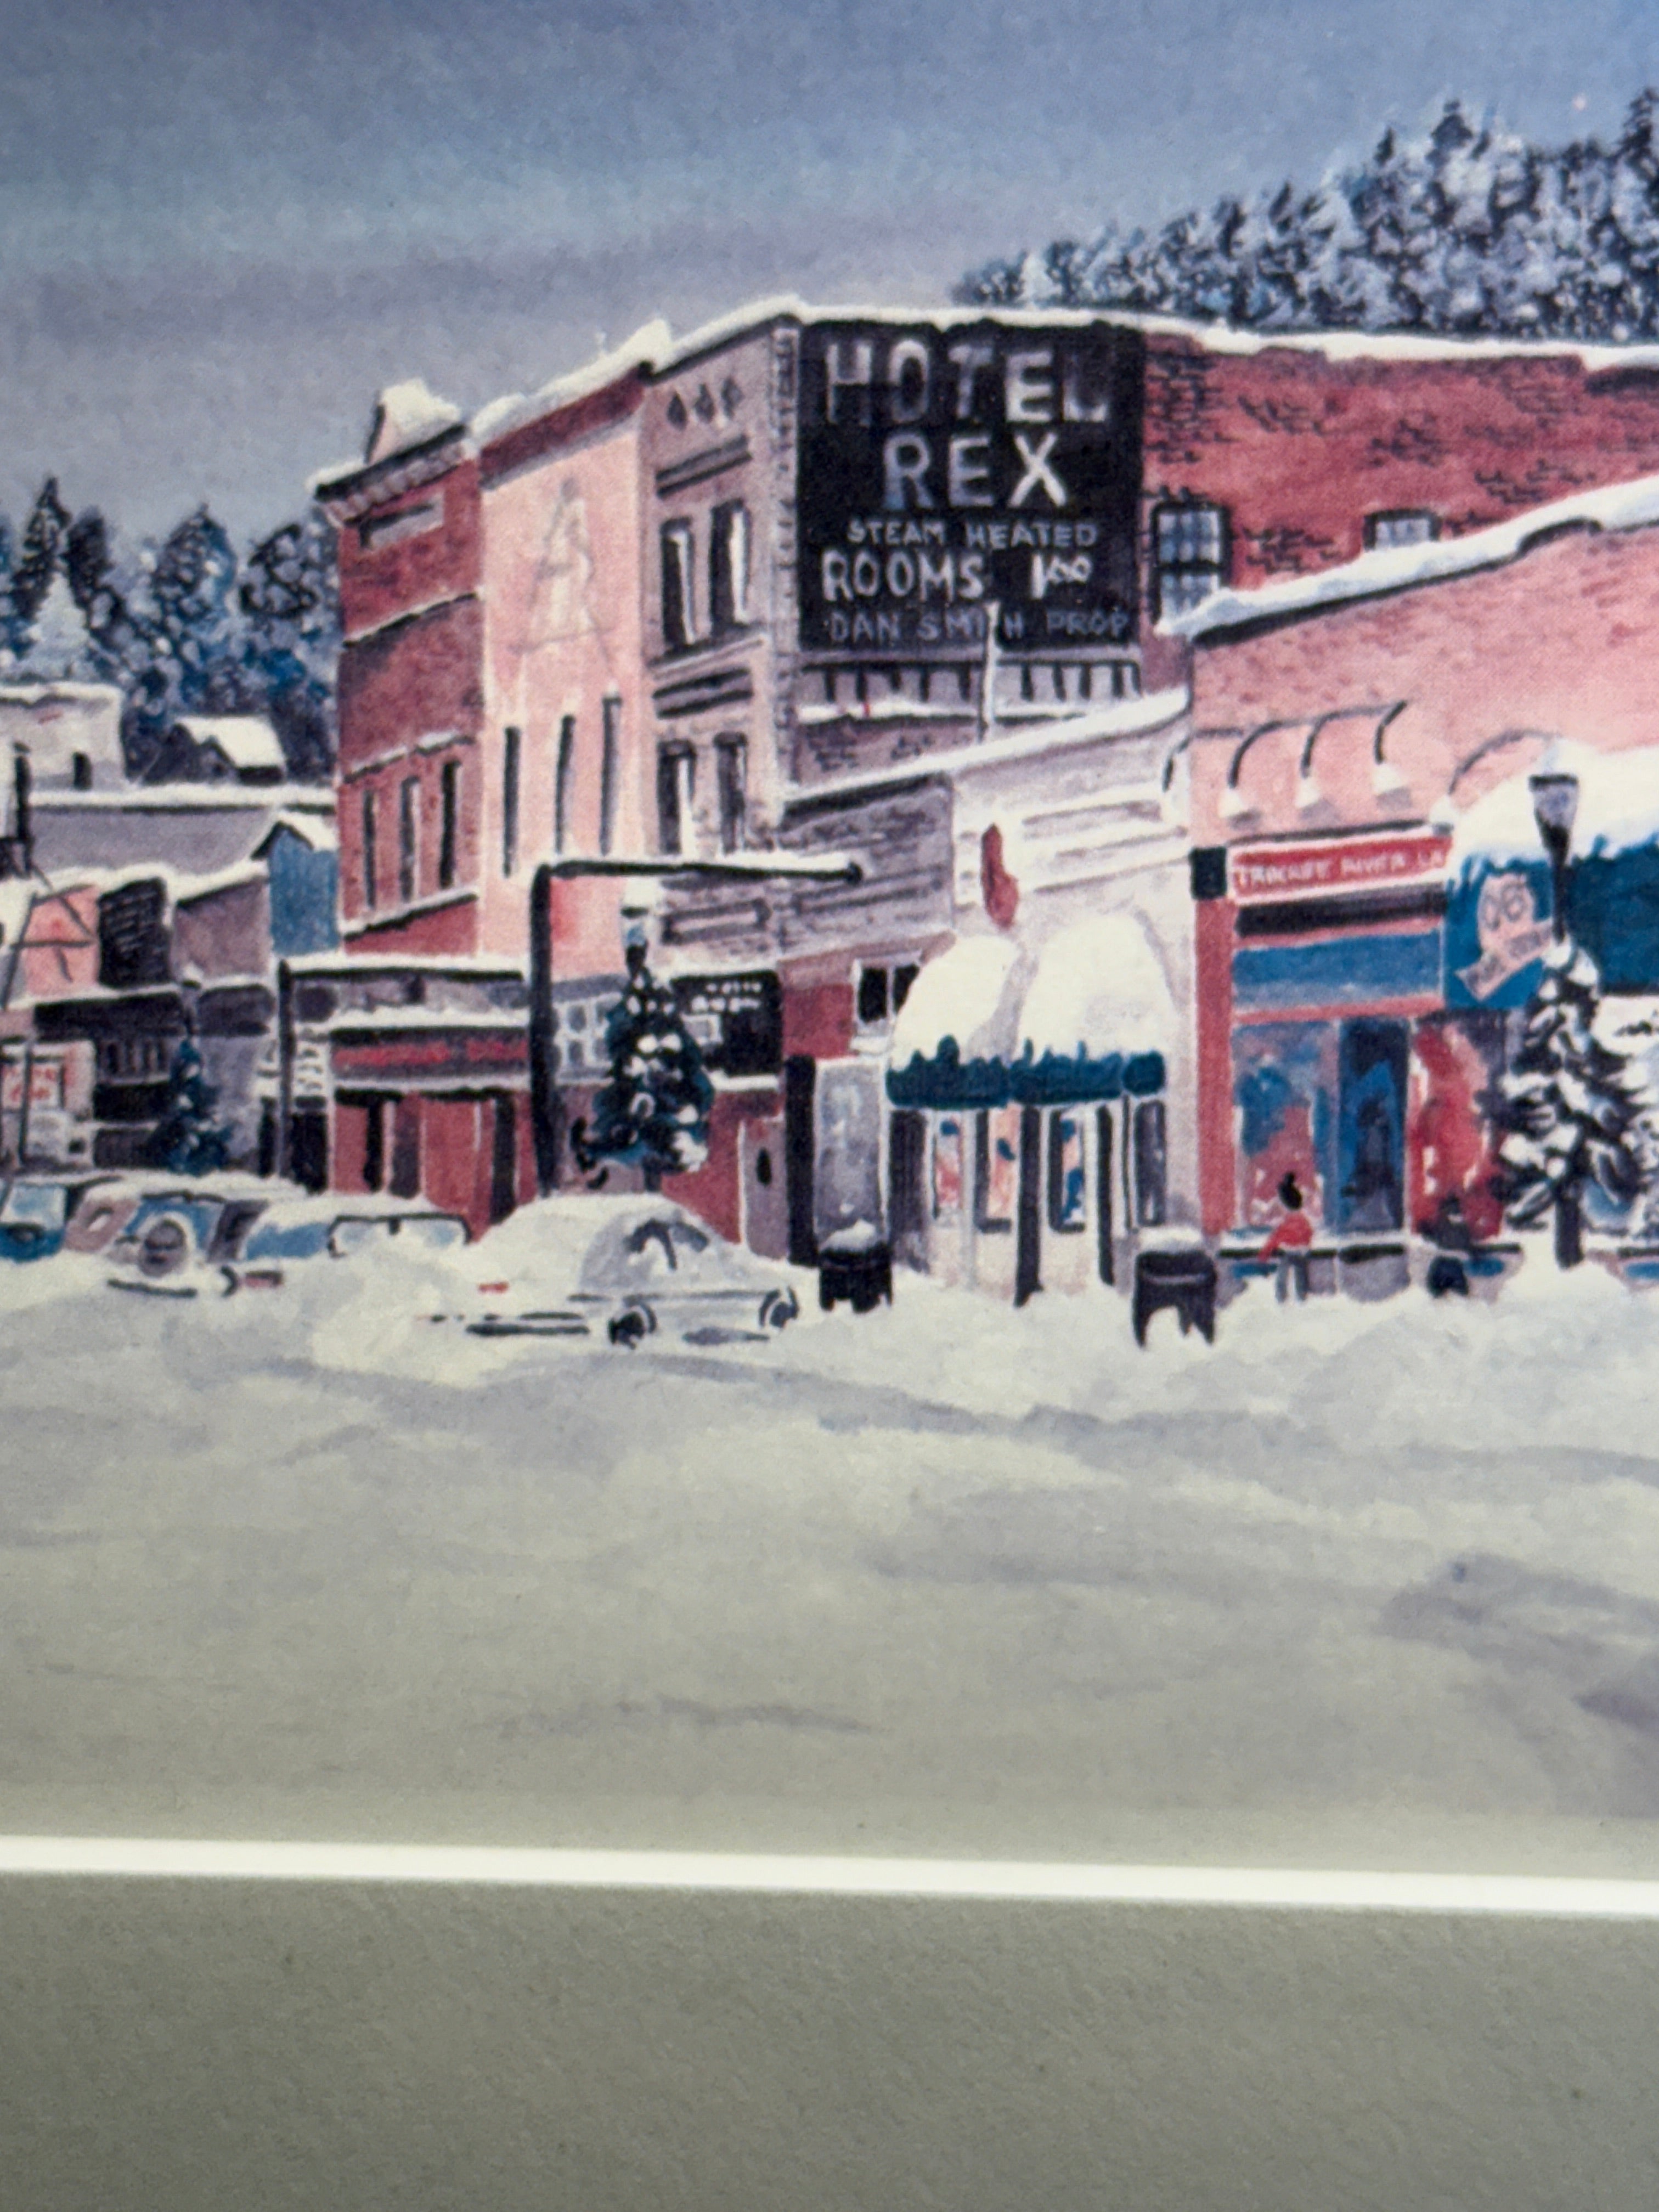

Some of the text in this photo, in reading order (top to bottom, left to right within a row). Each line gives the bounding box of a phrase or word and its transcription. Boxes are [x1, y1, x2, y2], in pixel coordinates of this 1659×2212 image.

[824, 338, 1108, 426] HOTEL
[881, 431, 1069, 509] REX
[845, 516, 1098, 549] STEAM HEATED
[822, 549, 984, 601] ROOMS
[827, 607, 1128, 643] DAN SMIH PROP
